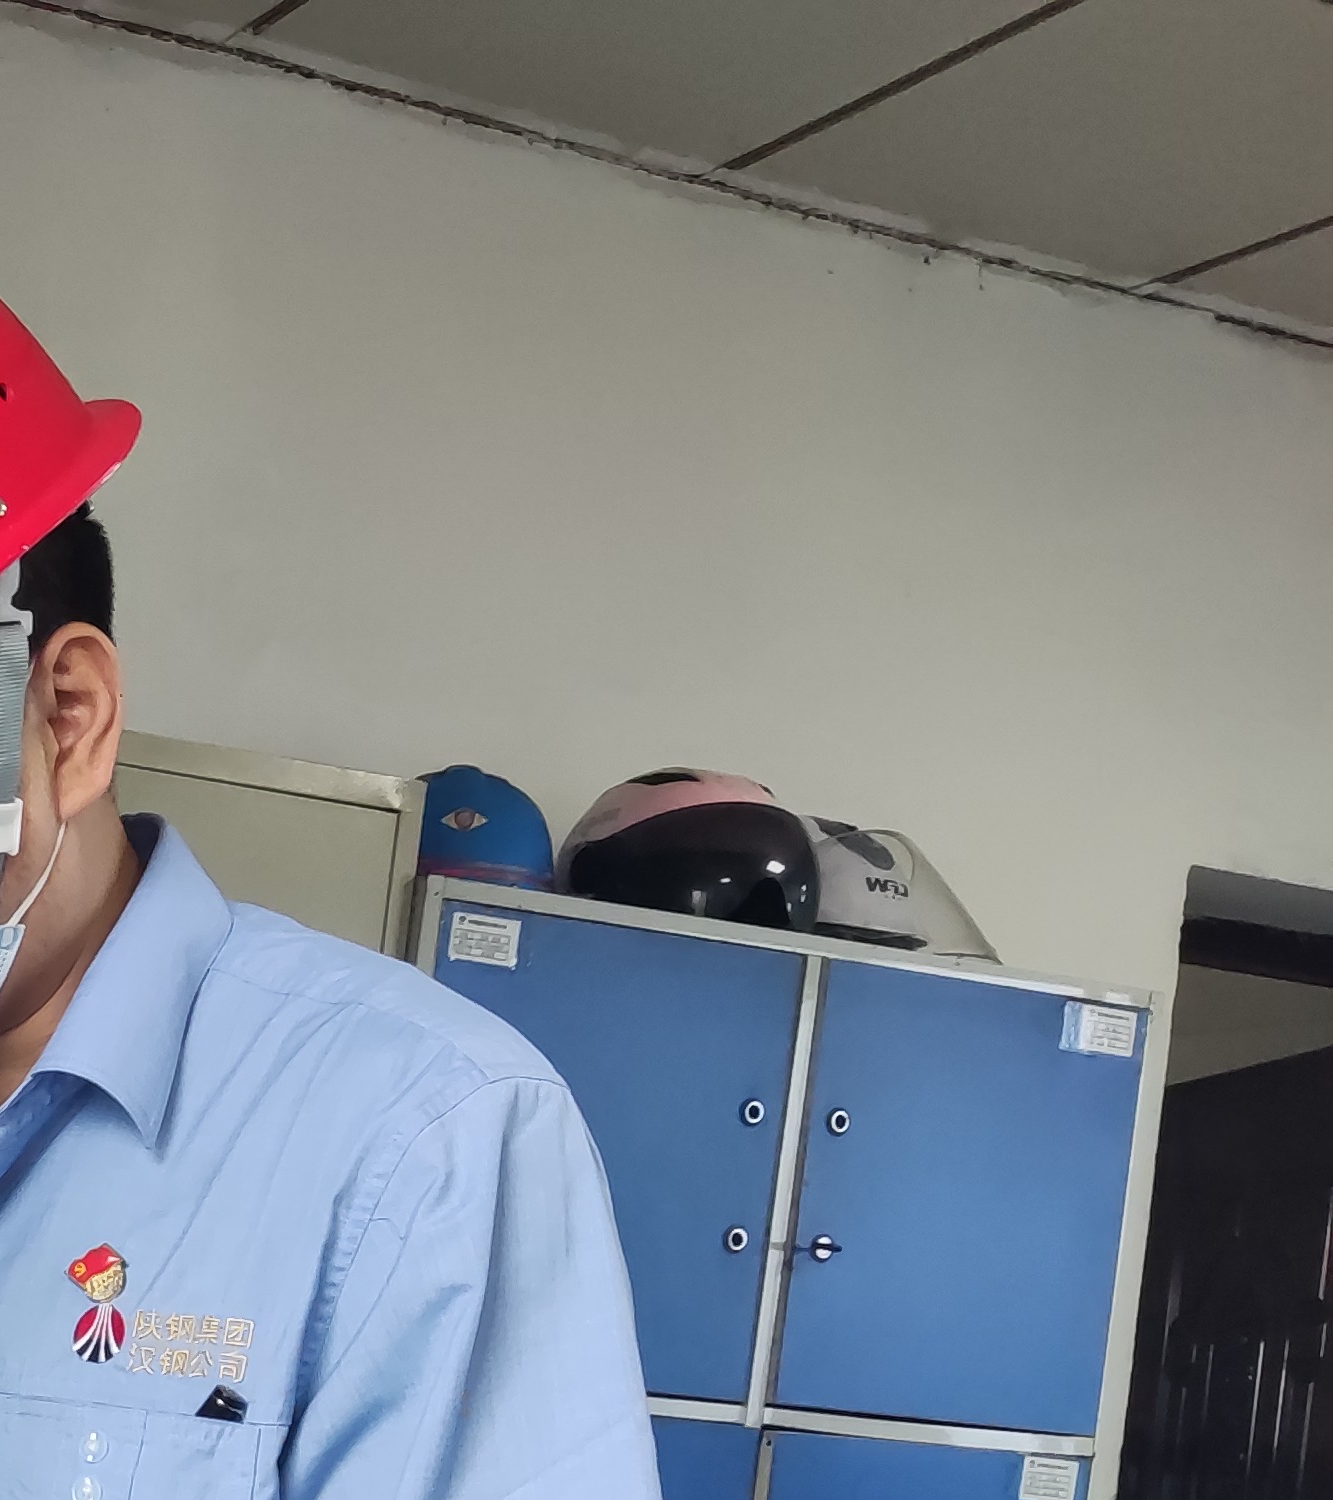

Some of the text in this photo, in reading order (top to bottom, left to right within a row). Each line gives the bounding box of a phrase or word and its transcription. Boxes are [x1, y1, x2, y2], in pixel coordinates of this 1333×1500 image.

[131, 1308, 255, 1350] 陕钢集团
[125, 1342, 250, 1384] 汉钢公司
